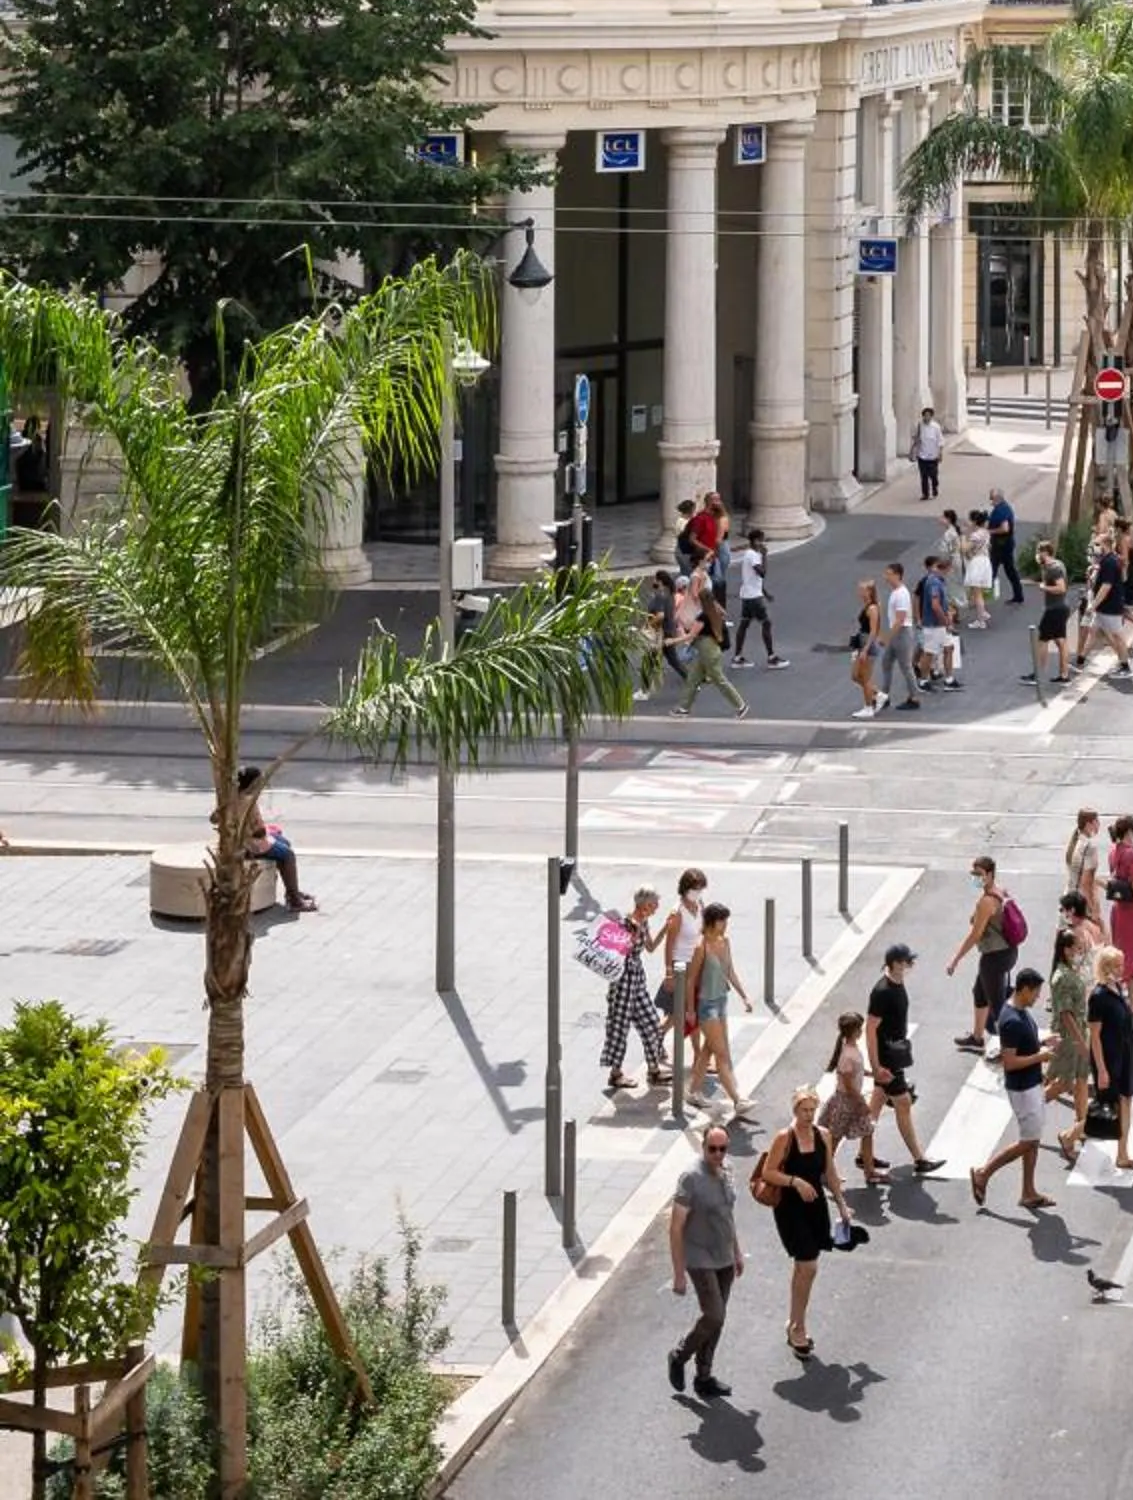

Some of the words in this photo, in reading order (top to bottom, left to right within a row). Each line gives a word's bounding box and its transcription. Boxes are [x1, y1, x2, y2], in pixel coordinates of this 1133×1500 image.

[742, 132, 759, 145] LCL
[605, 139, 636, 151] LCL
[861, 246, 890, 257] LCL
